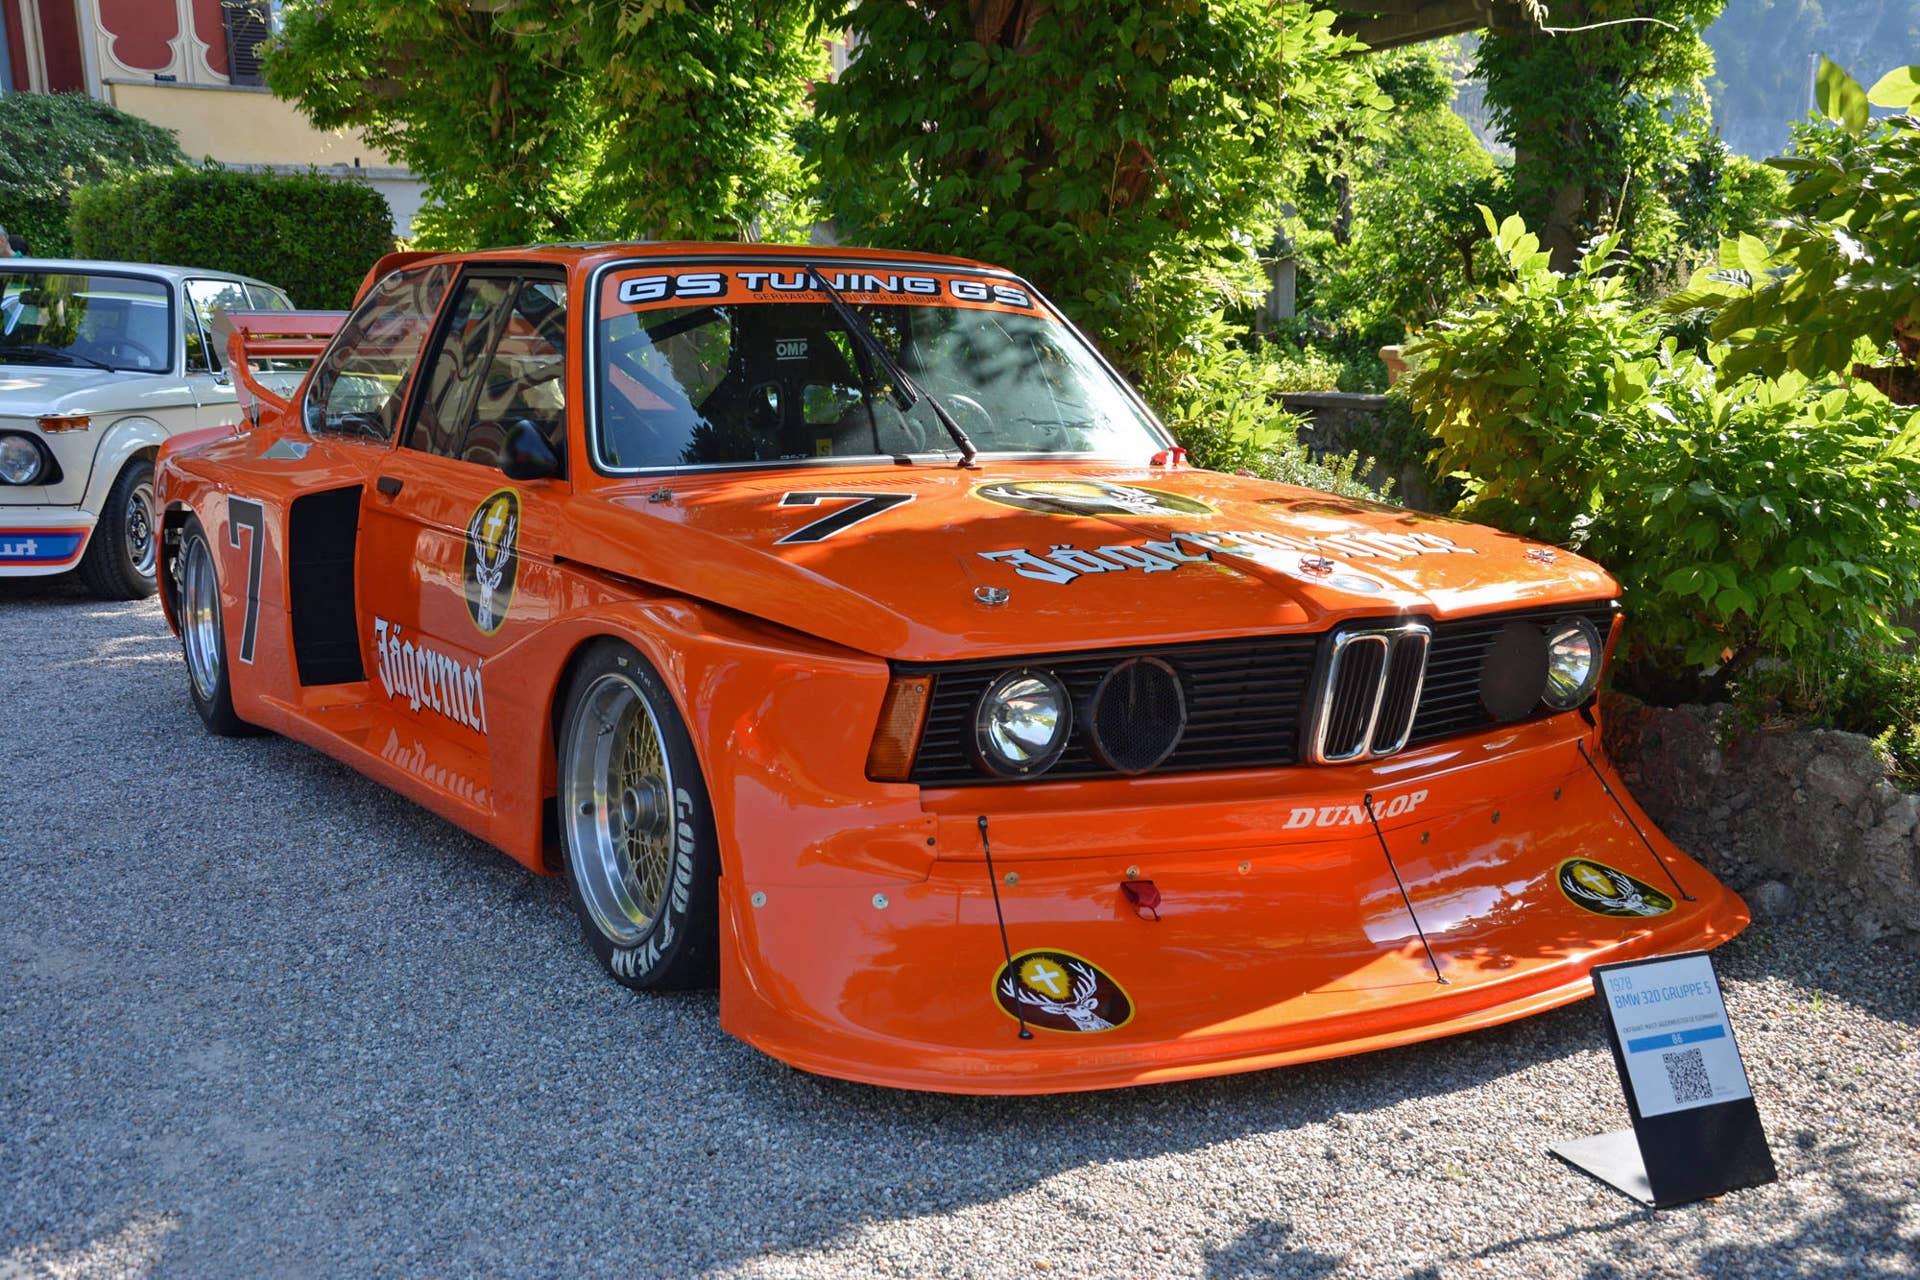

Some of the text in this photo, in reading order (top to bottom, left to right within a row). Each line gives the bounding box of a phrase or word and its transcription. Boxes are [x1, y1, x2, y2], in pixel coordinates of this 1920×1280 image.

[618, 272, 1034, 309] GS TUNING GS
[753, 293, 816, 301] GERHARD
[776, 342, 808, 356] OMP
[773, 490, 918, 545] 7
[227, 494, 266, 665] 7
[1282, 789, 1429, 829] DUNLOP
[1609, 976, 1633, 993] 1978
[1614, 994, 1641, 1009] BMW
[1642, 990, 1661, 1004] 320
[1662, 983, 1704, 1001] GRUPPE
